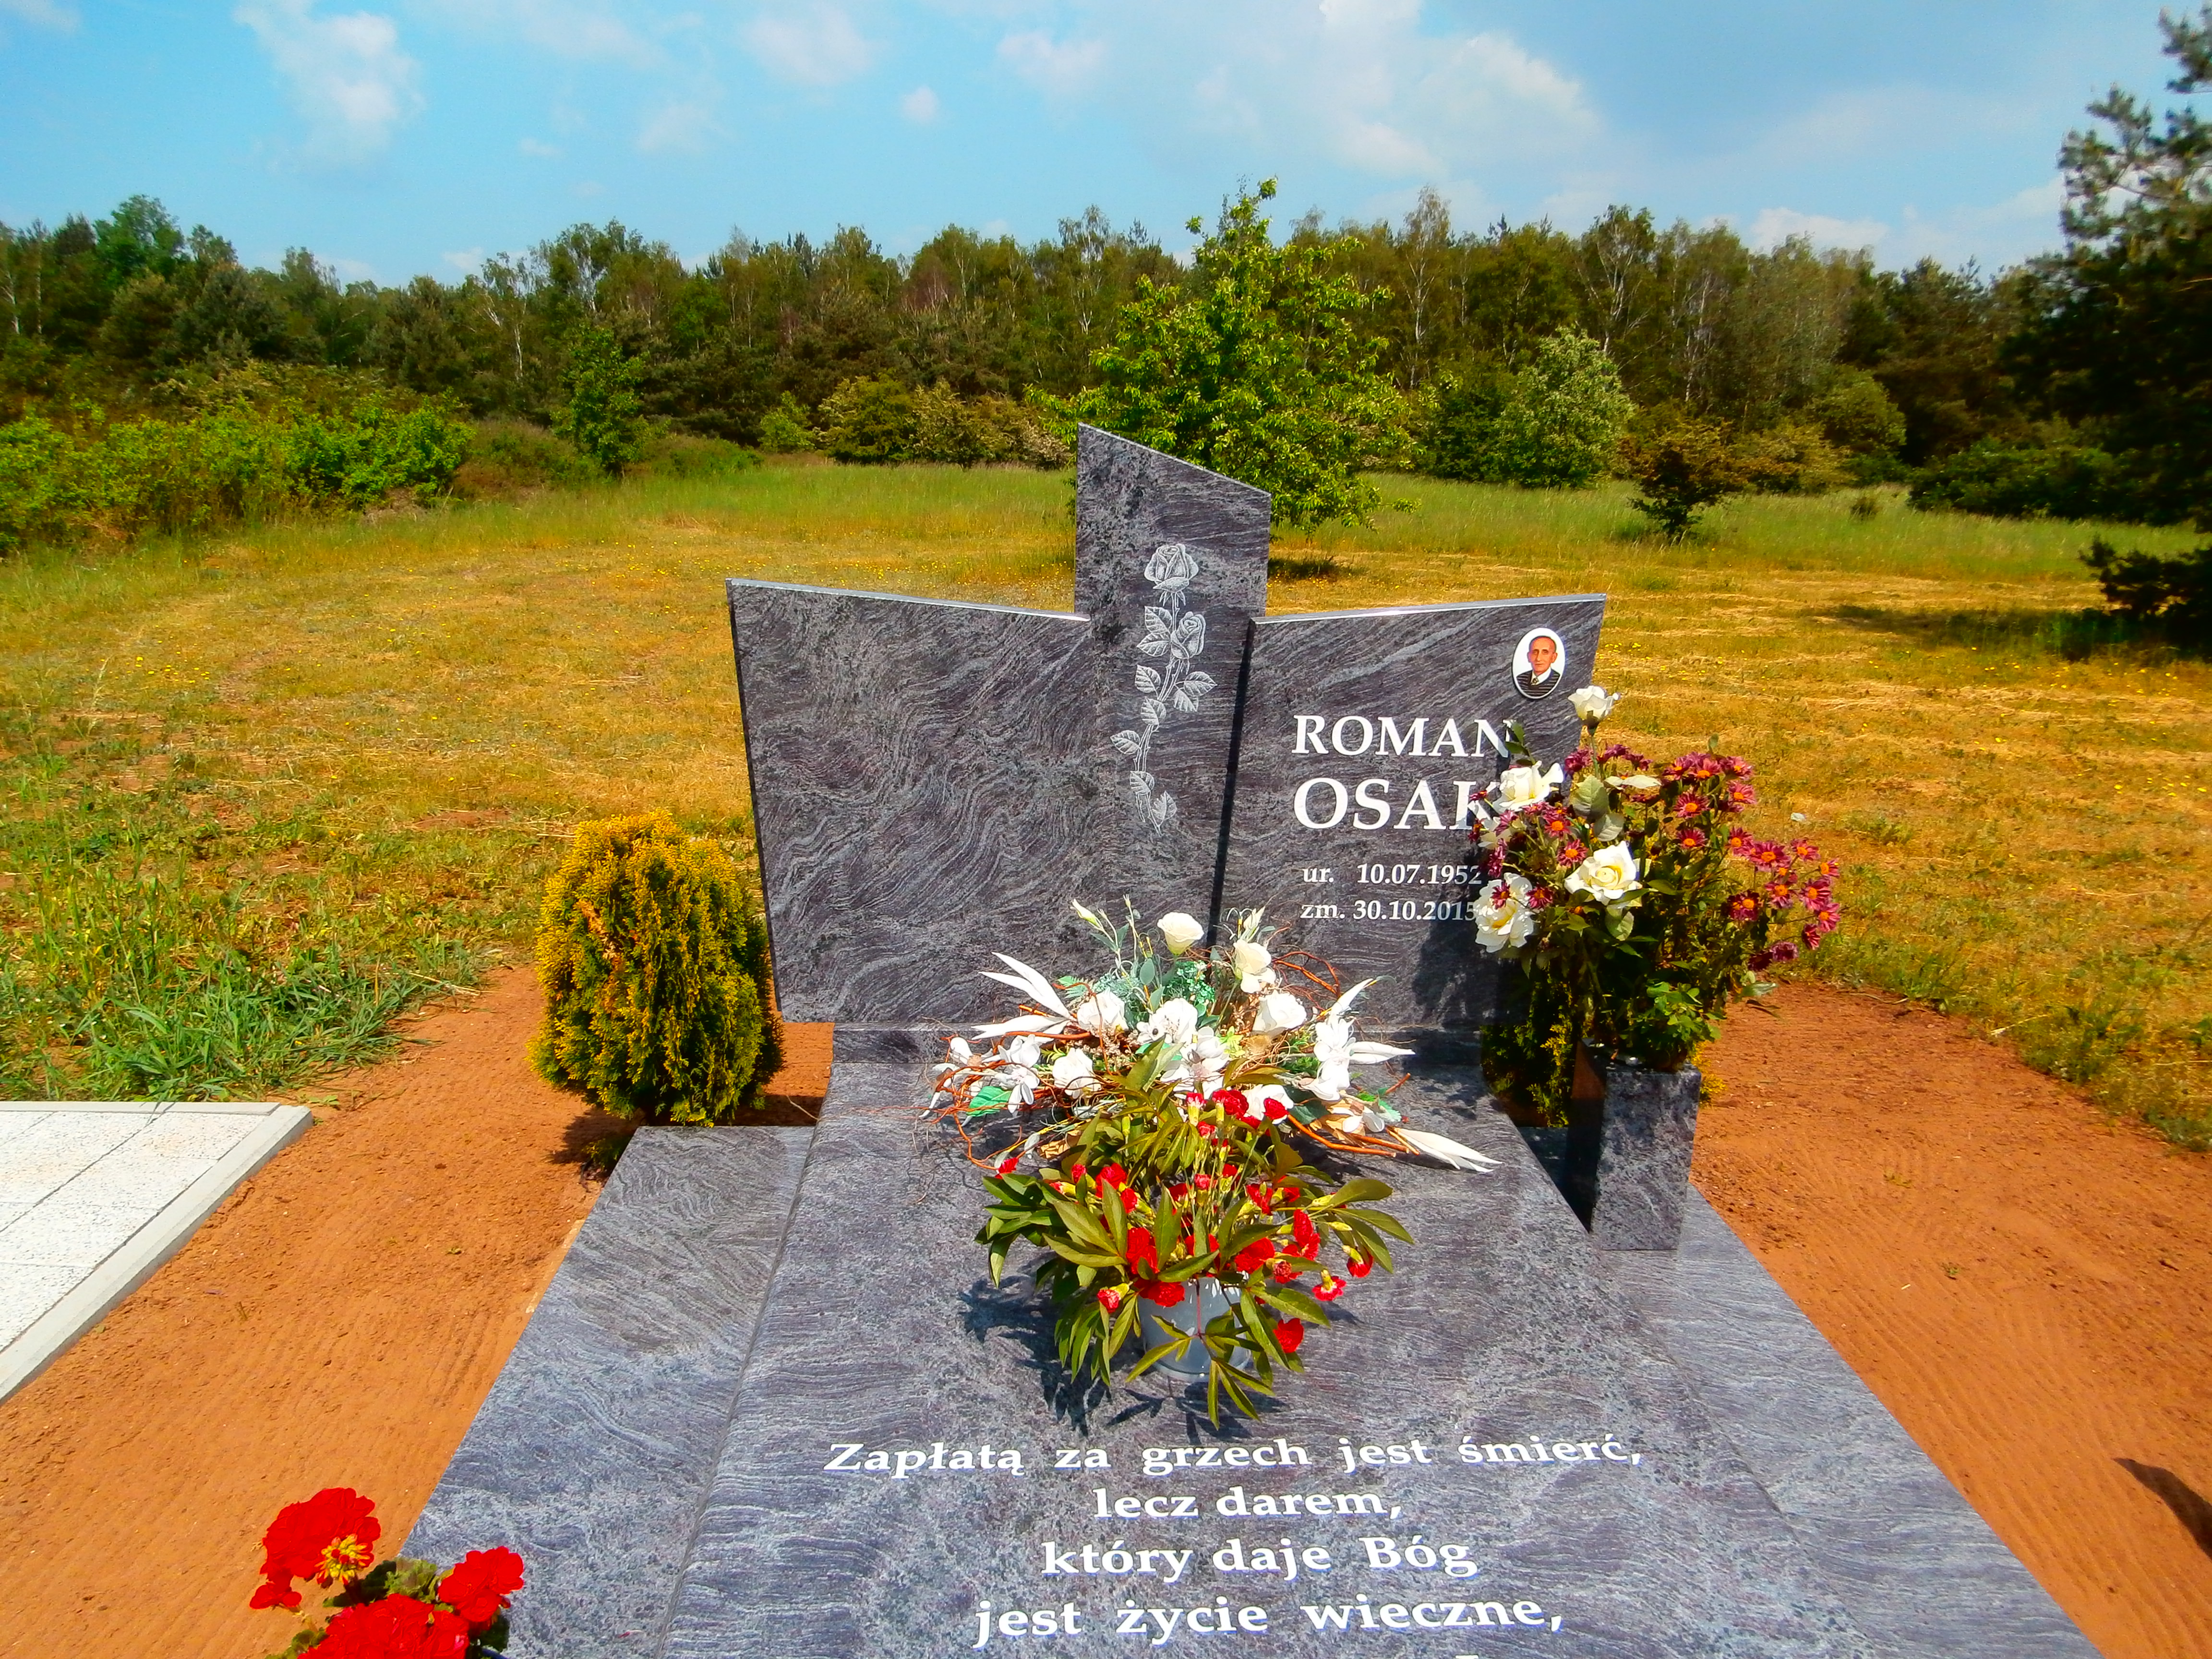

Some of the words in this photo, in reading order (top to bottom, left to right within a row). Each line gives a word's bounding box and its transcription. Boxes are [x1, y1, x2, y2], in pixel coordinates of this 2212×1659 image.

[1291, 715, 1516, 758] ROMAN
[1294, 778, 1500, 830] OSAK
[1302, 867, 1334, 883] ur.
[1357, 863, 1482, 885] 10.07.1952
[1300, 904, 1346, 919] zm.
[1353, 900, 1477, 921] 30.10.2015
[823, 1442, 1024, 1479] Zapłatą
[1054, 1448, 1111, 1468] za
[1142, 1438, 1313, 1476] grzech
[1337, 1437, 1432, 1474] jest
[1457, 1433, 1642, 1466] śmierć,
[1092, 1488, 1199, 1518] lecz
[1215, 1486, 1403, 1520] darem,
[1041, 1539, 1194, 1583] który
[1212, 1538, 1332, 1581] daje
[1358, 1535, 1478, 1578] Bóg
[972, 1599, 1083, 1649] jest
[1116, 1596, 1269, 1646] życie
[1299, 1593, 1563, 1632] wieczne,
